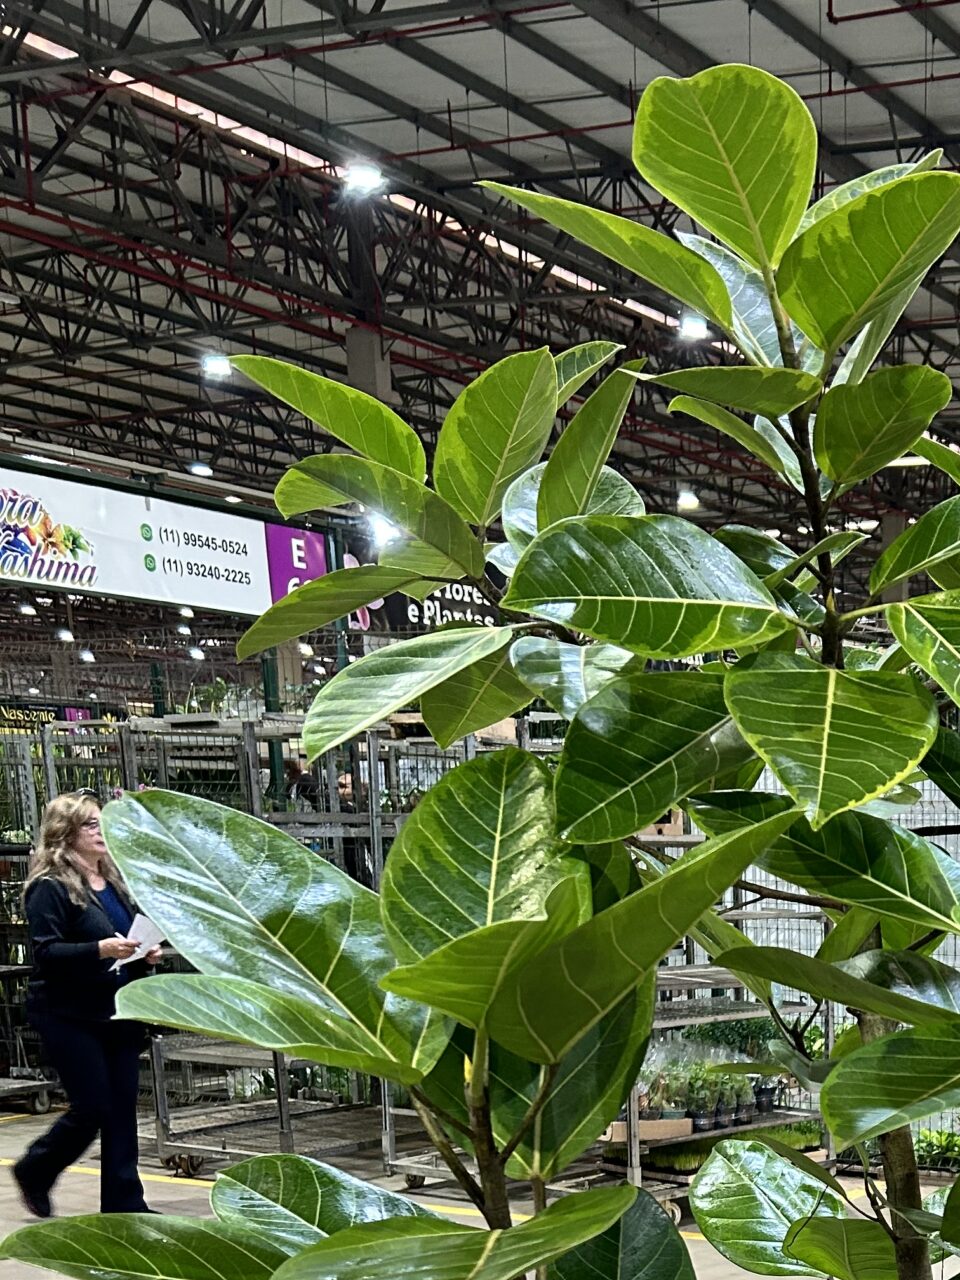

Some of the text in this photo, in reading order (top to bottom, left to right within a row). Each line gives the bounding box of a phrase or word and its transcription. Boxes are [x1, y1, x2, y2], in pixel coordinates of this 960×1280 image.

[0, 495, 43, 527] ra
[159, 527, 248, 556] (11) 99545-0524
[291, 538, 307, 570] E
[0, 535, 98, 588] ashima
[162, 557, 251, 585] (11) 93240-2225
[408, 603, 420, 623] e
